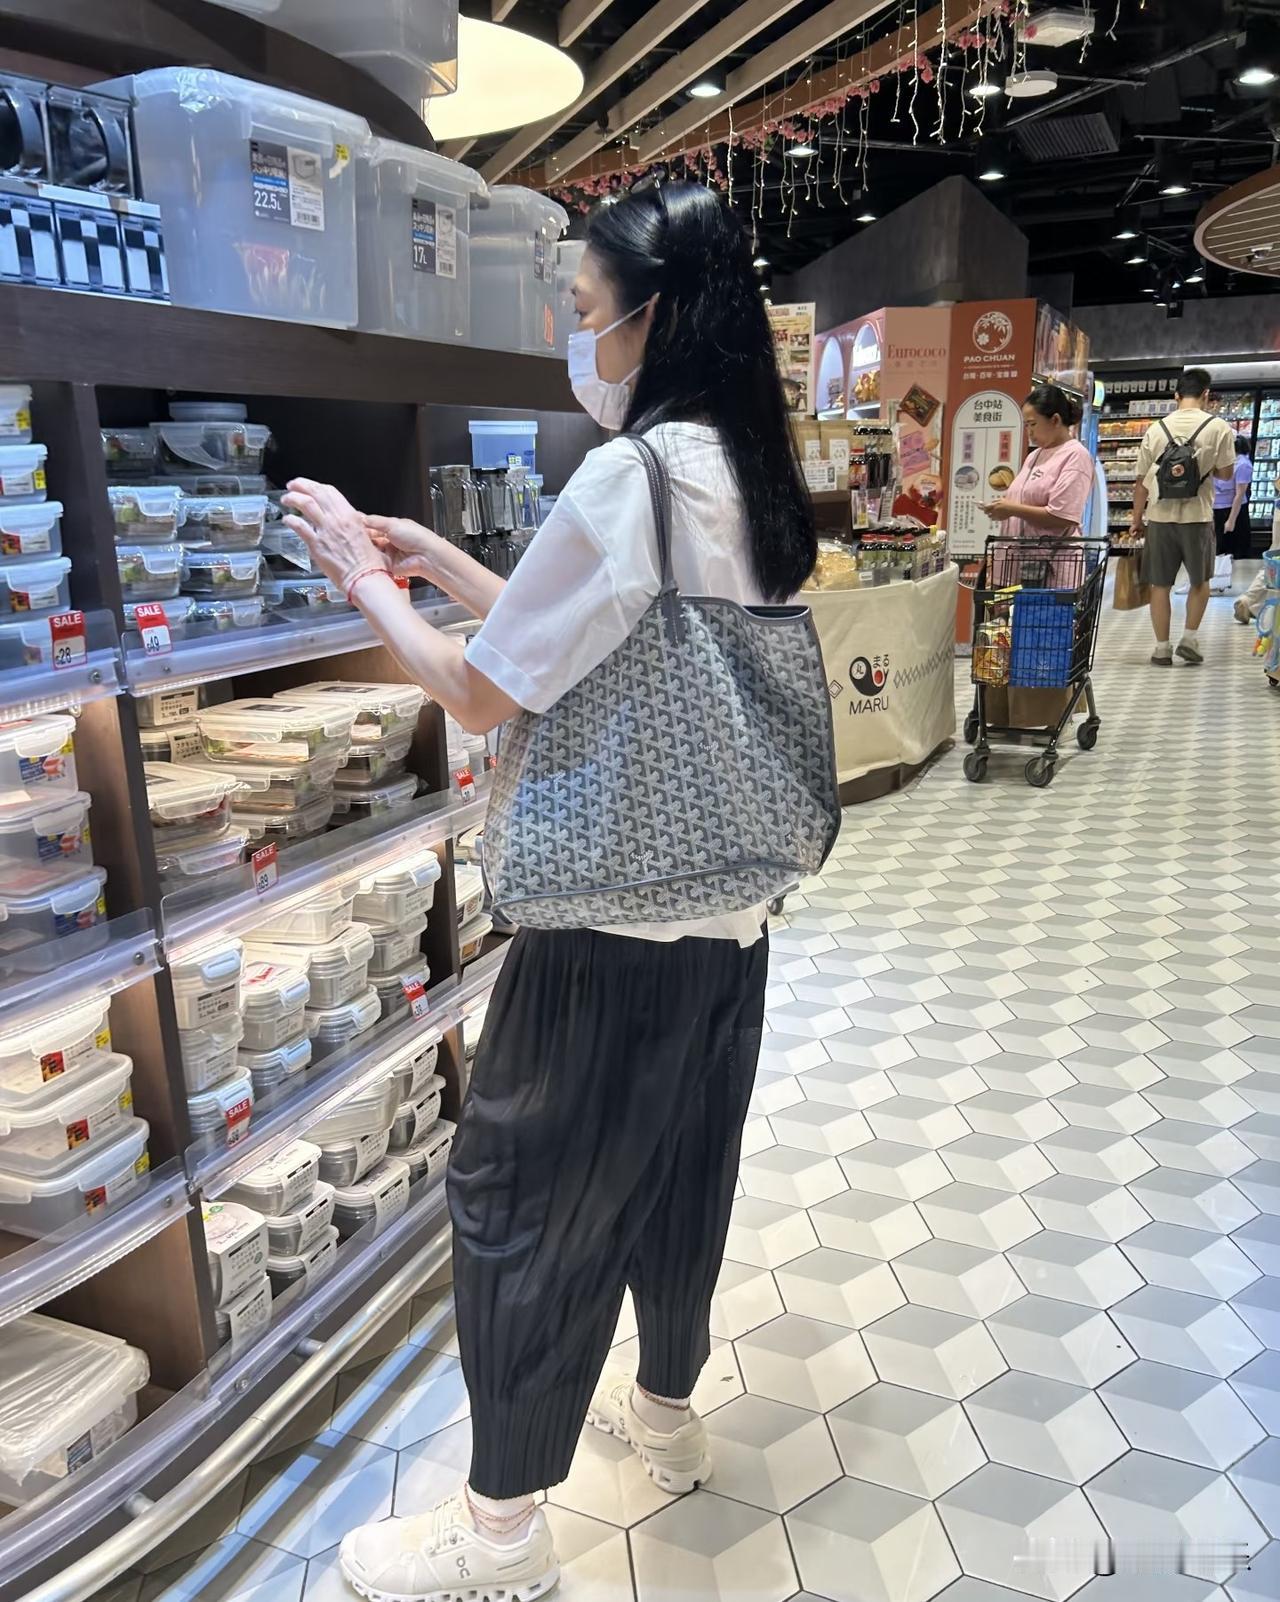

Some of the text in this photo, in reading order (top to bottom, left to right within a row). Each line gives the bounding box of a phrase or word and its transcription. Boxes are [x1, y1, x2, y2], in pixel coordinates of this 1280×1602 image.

[887, 345, 947, 360] Eurococo
[963, 354, 1016, 363] PAO CHUAN
[974, 399, 1003, 410] 台中站
[973, 411, 1003, 423] 美食街
[136, 604, 162, 618] SALE
[54, 613, 82, 628] SALE
[849, 696, 889, 716] MARU
[255, 845, 275, 862] SALE
[228, 1099, 248, 1118] SALE
